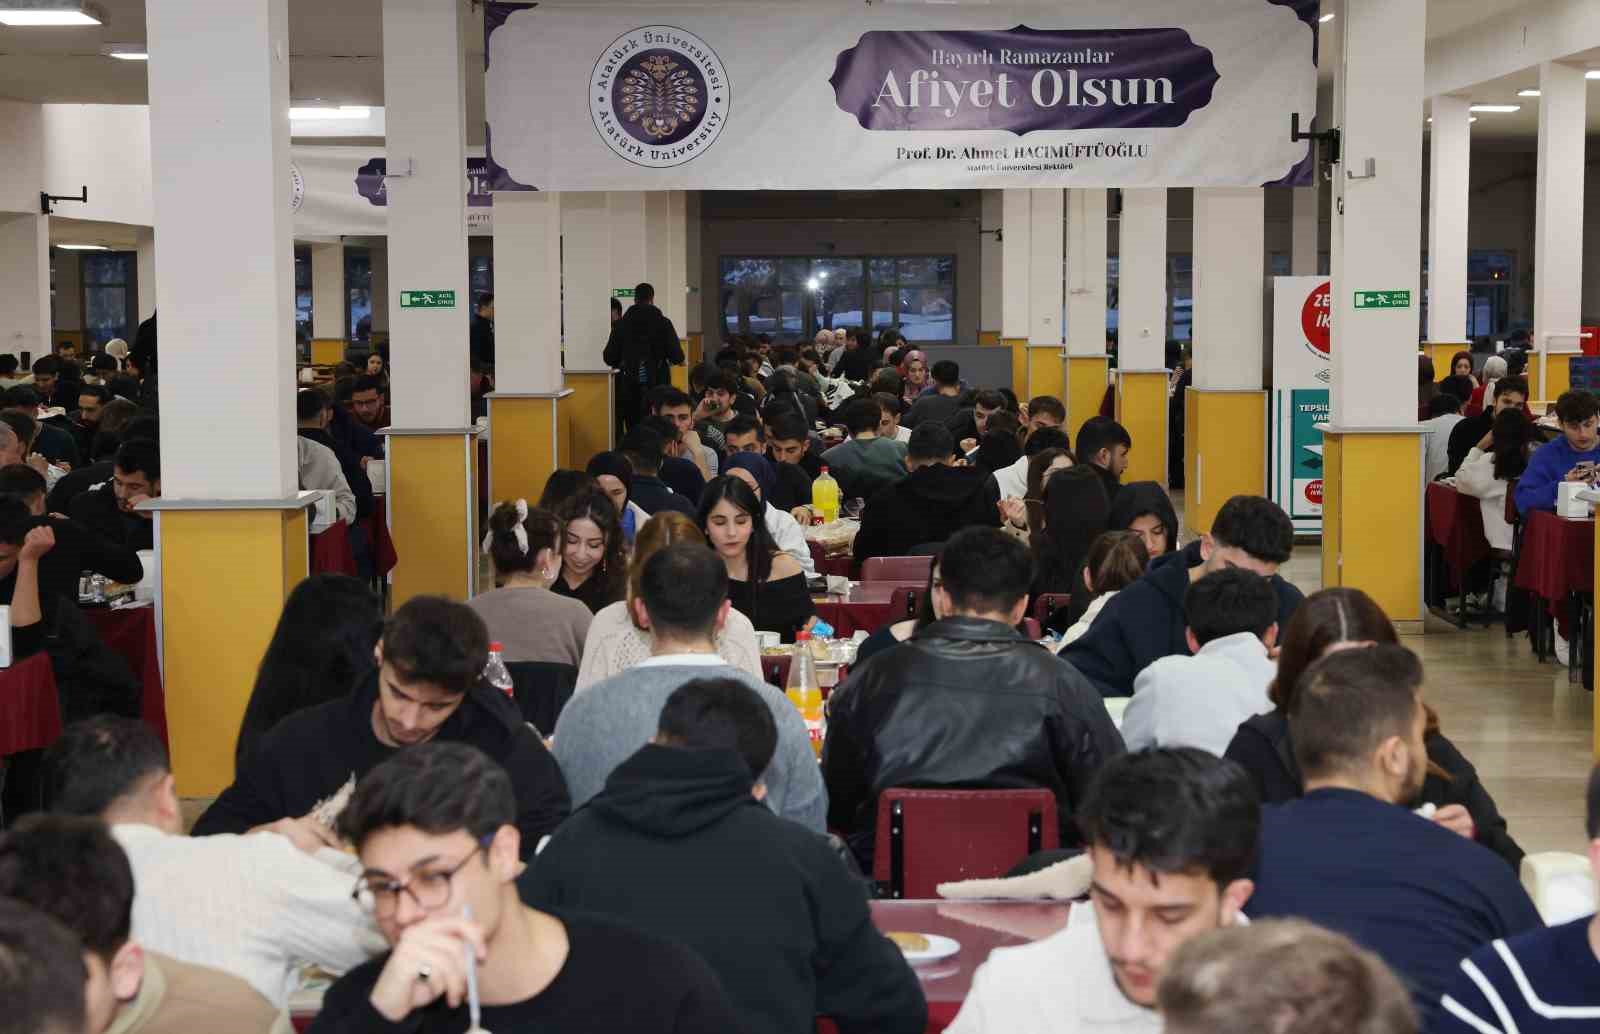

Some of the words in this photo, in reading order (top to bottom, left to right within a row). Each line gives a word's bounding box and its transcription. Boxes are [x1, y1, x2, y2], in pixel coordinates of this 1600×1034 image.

[598, 38, 639, 89] Atatürk
[643, 31, 724, 91] Üniversitesi
[1000, 48, 1115, 65] Ramazanlar
[871, 69, 1017, 118] Afiyet
[1031, 68, 1175, 108] Olsun
[598, 110, 645, 158] Atatürk
[650, 111, 722, 160] University
[896, 146, 932, 160] Prof.
[936, 146, 957, 160] Dr.
[960, 146, 1009, 160] Ahmet
